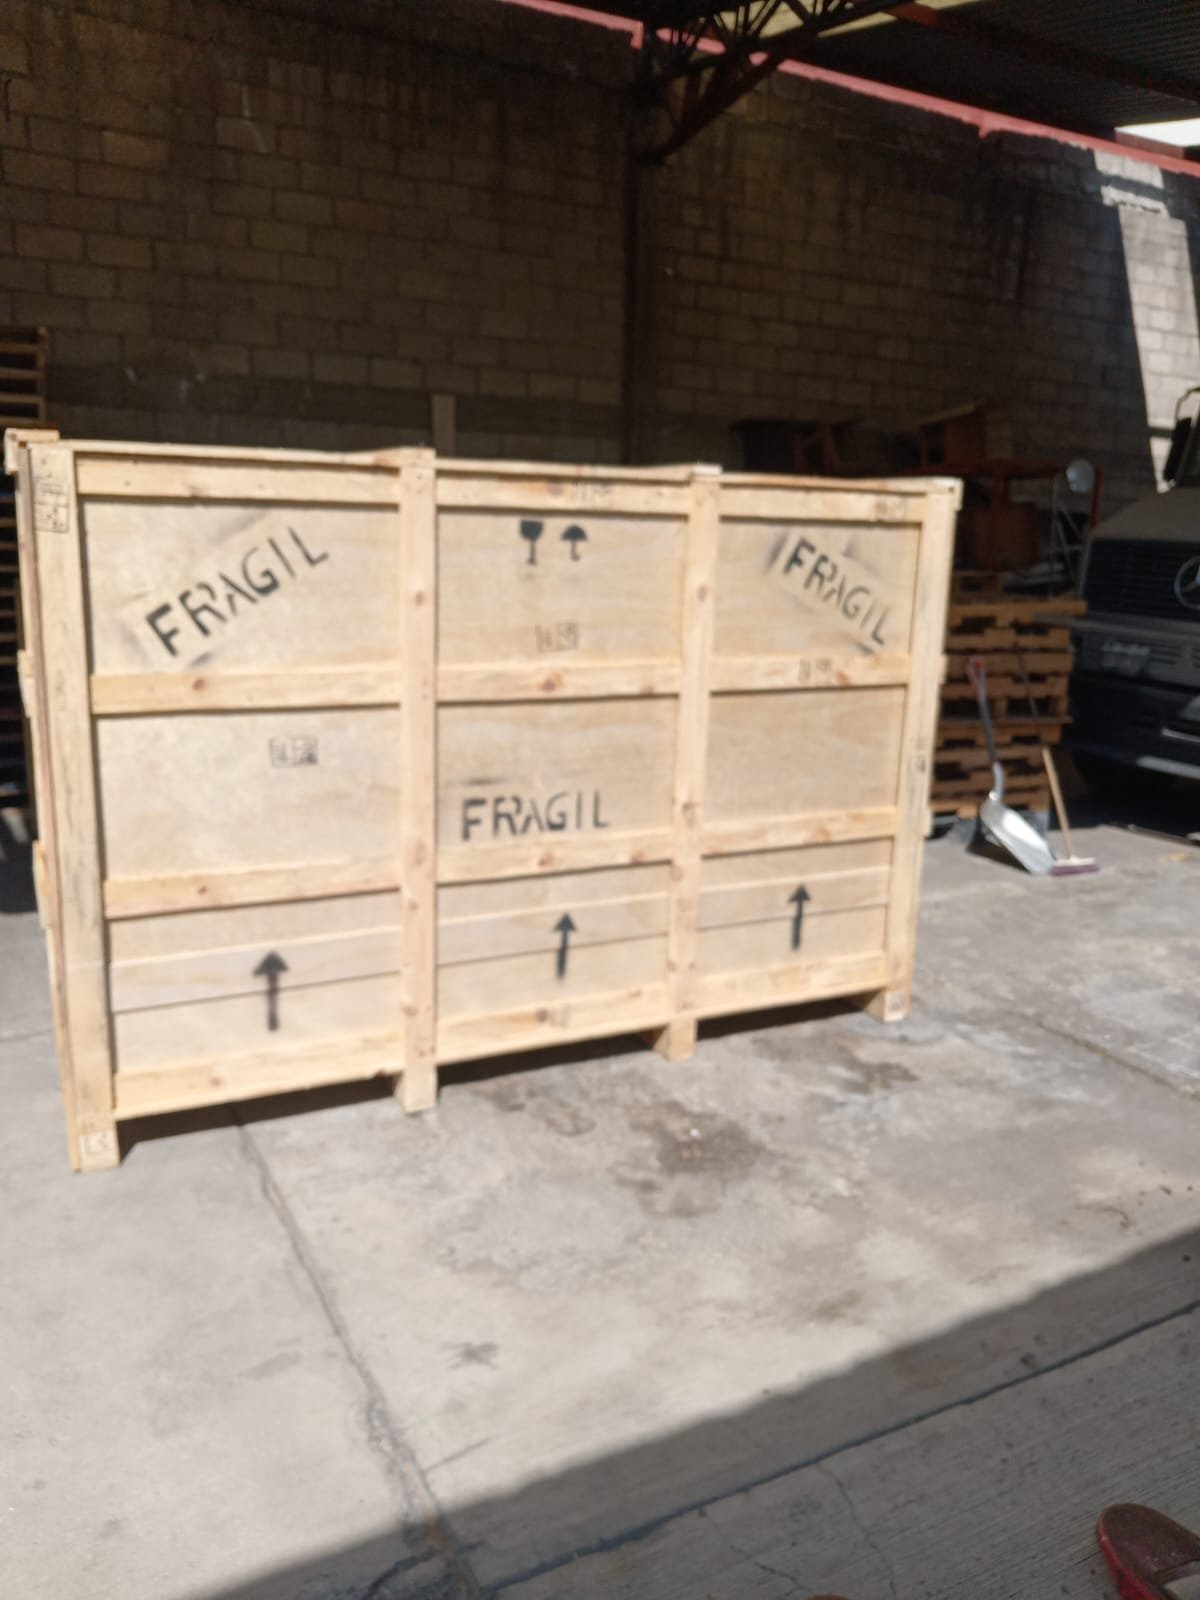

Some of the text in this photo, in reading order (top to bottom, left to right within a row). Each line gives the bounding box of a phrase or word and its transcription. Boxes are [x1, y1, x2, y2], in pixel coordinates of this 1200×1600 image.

[145, 526, 329, 656] FRAGIL
[783, 537, 890, 646] FRAGIL
[461, 790, 609, 841] FRAGIL
